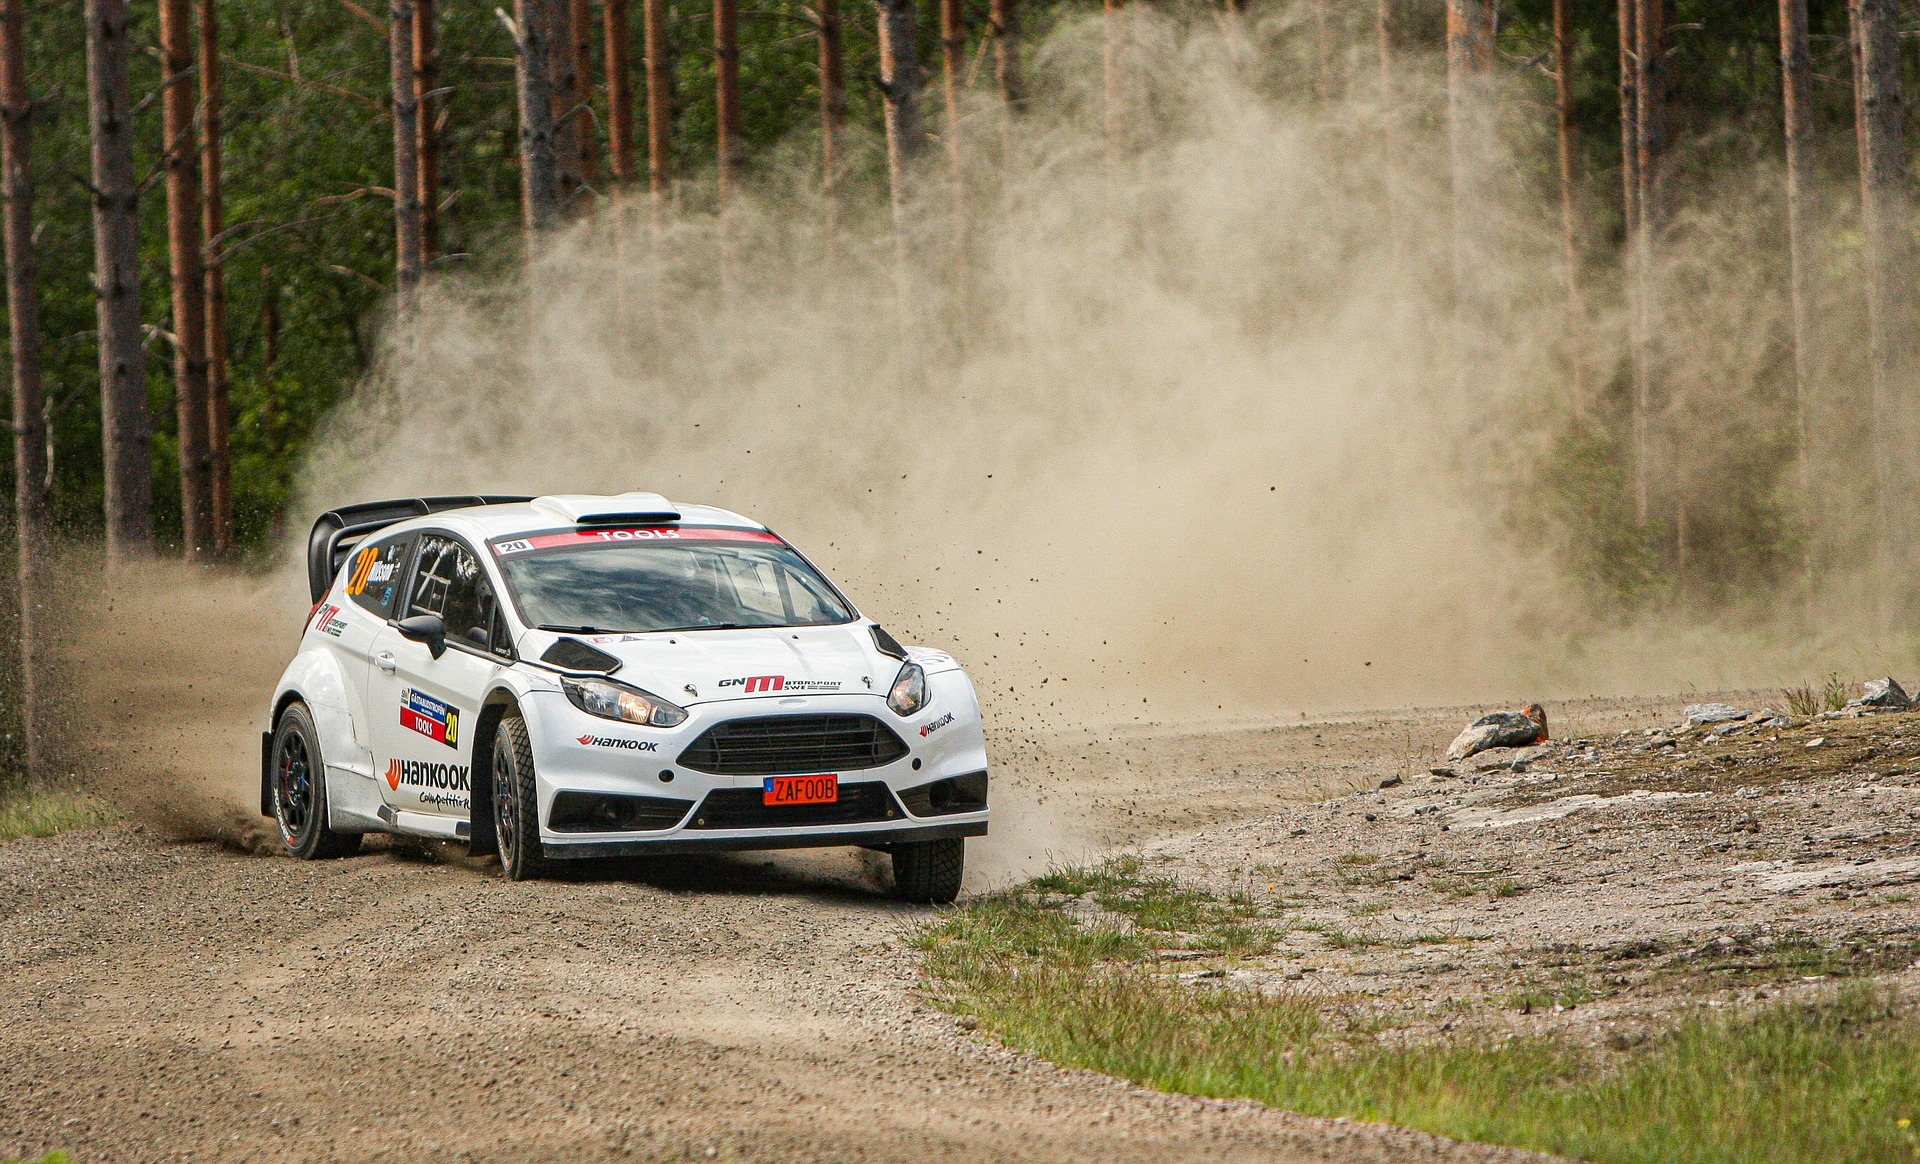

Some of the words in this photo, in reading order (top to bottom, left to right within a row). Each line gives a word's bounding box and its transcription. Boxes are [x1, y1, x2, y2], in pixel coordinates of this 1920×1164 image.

[597, 529, 681, 542] TOOLS
[501, 541, 527, 552] 20
[343, 547, 379, 595] 20
[415, 716, 433, 736] TOOLS
[445, 712, 457, 743] 20
